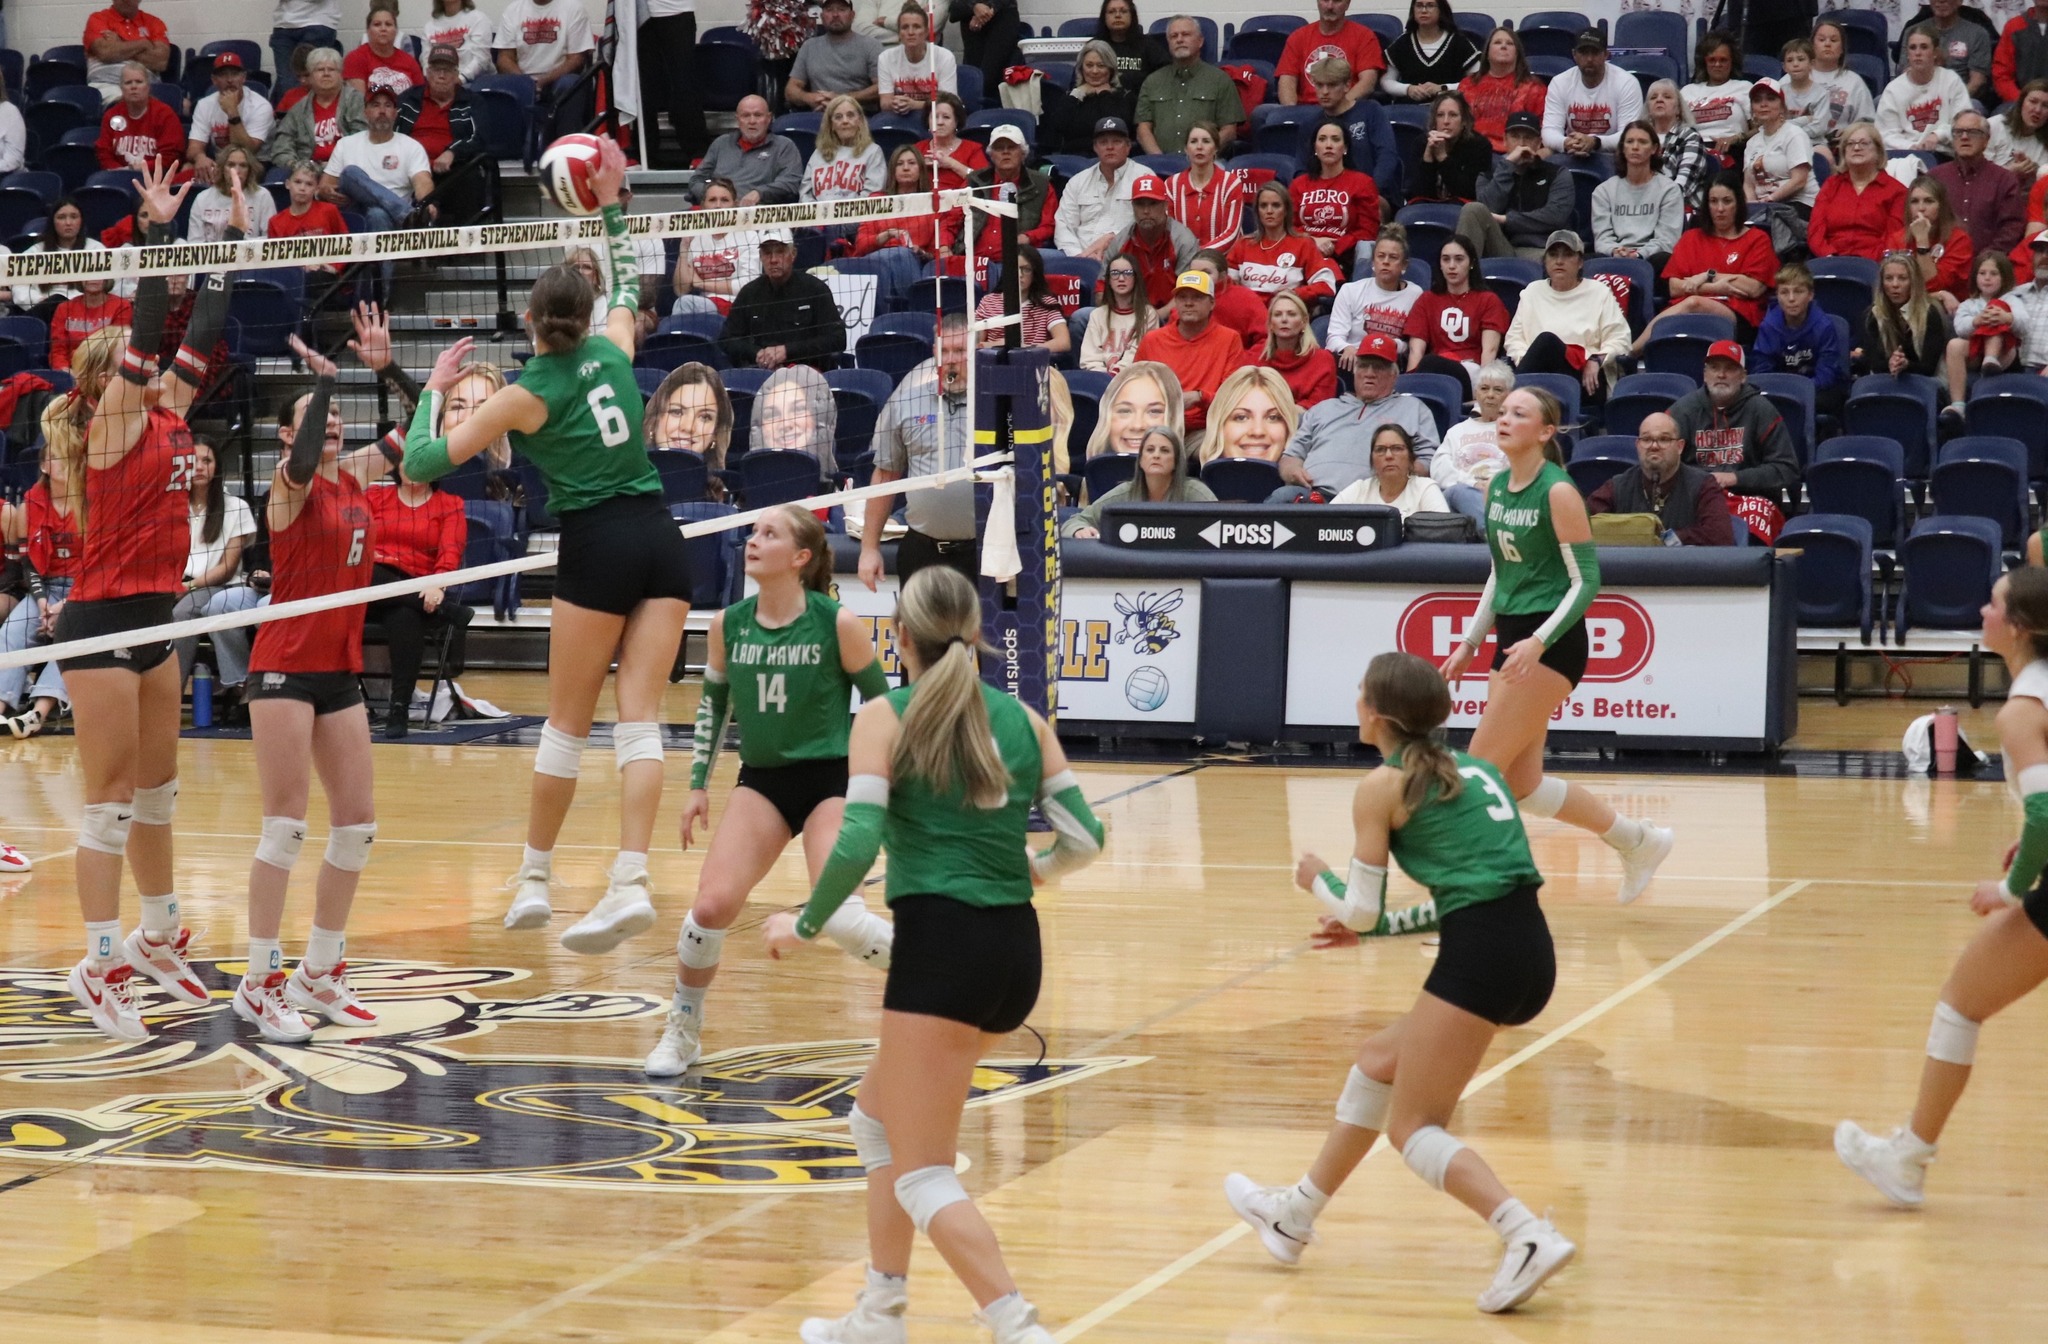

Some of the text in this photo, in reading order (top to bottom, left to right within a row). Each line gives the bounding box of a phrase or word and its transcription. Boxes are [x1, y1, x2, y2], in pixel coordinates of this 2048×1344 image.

[813, 161, 866, 196] EAGLES
[1138, 179, 1153, 191] H
[833, 197, 894, 219] STEPHENVILLE
[1300, 189, 1350, 207] HERO
[668, 210, 738, 232] STEPHENVILLE
[753, 203, 817, 225] STEPHENVILLE
[375, 228, 460, 254] STEPHENVILLE
[480, 222, 559, 246] STEPHENVILLE
[138, 243, 238, 270] STEPHENVILLE
[261, 236, 354, 262] STEPHENVILLE
[6, 251, 113, 278] STEPHENVILLE
[1241, 265, 1290, 288] Eagles
[1440, 307, 1470, 342] OU
[586, 383, 631, 448] 6
[1140, 526, 1176, 540] BONUS
[1221, 523, 1273, 545] POSS
[1318, 529, 1354, 542] BONUS
[346, 528, 366, 567] 6
[1496, 529, 1523, 563] 16
[731, 641, 822, 666] LADY HAWKS
[1003, 628, 1021, 680] sports
[756, 673, 788, 714] 14
[1592, 697, 1678, 719] Better.
[1457, 766, 1515, 822] 3
